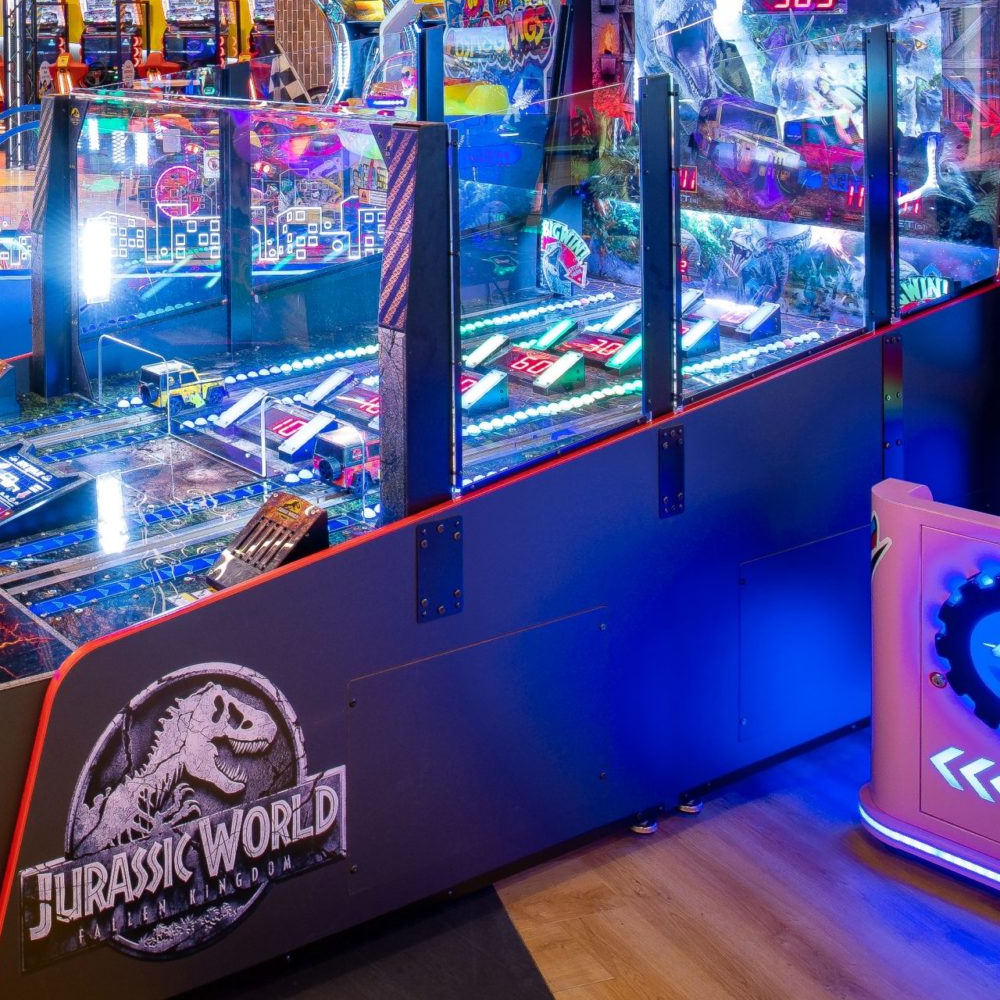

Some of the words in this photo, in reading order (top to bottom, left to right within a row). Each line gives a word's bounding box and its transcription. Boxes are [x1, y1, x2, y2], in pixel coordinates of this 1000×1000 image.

[29, 832, 193, 941] JURASSIC
[198, 785, 339, 878] WORLD
[79, 899, 167, 944] FALLEN
[189, 855, 293, 906] KINGDOM
